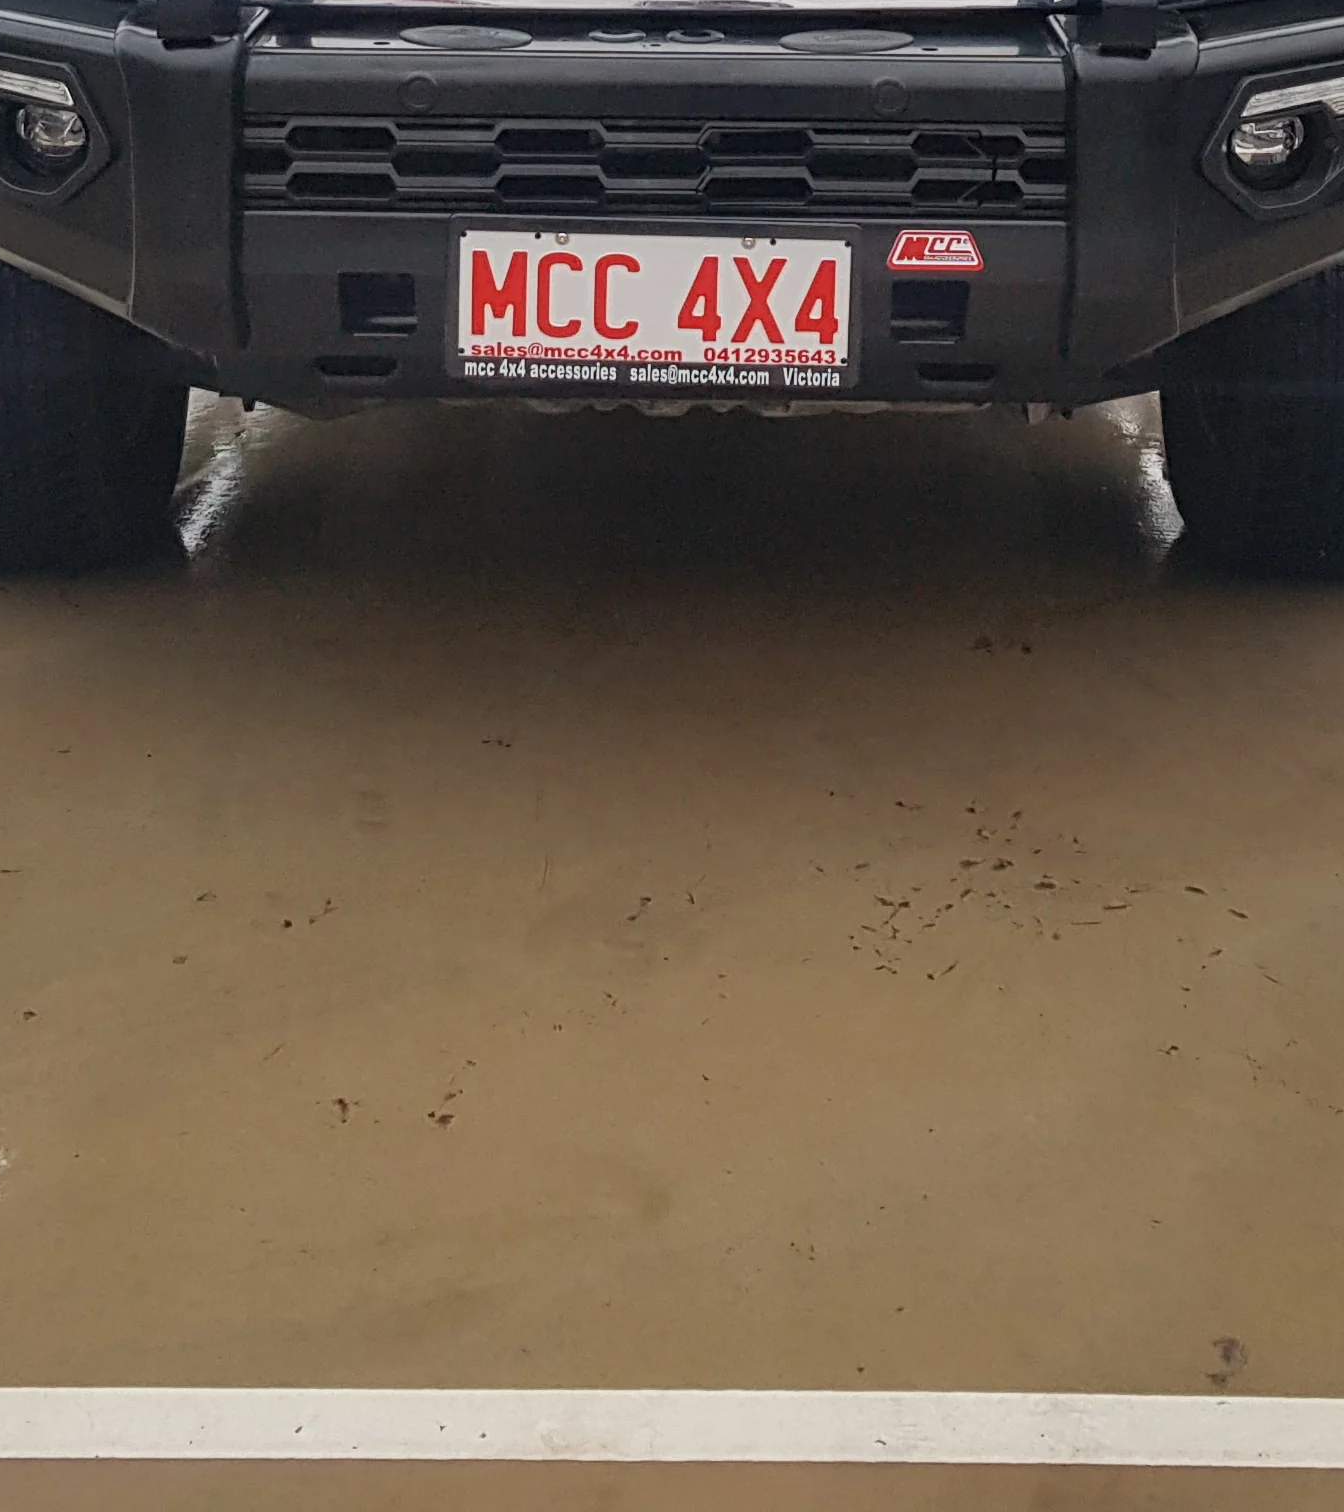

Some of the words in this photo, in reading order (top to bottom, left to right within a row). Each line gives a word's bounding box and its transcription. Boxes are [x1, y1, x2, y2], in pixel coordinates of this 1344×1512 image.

[471, 250, 641, 340] MCC
[677, 256, 840, 345] 4X4
[471, 342, 684, 363] sales@mcc4x4.com
[703, 347, 837, 365] 0412935643
[464, 361, 496, 377] mcc
[499, 359, 526, 378] 4x4
[529, 362, 618, 382] accessories
[629, 364, 771, 386] sales@mcc4x4.com
[782, 367, 841, 387] Victoria
